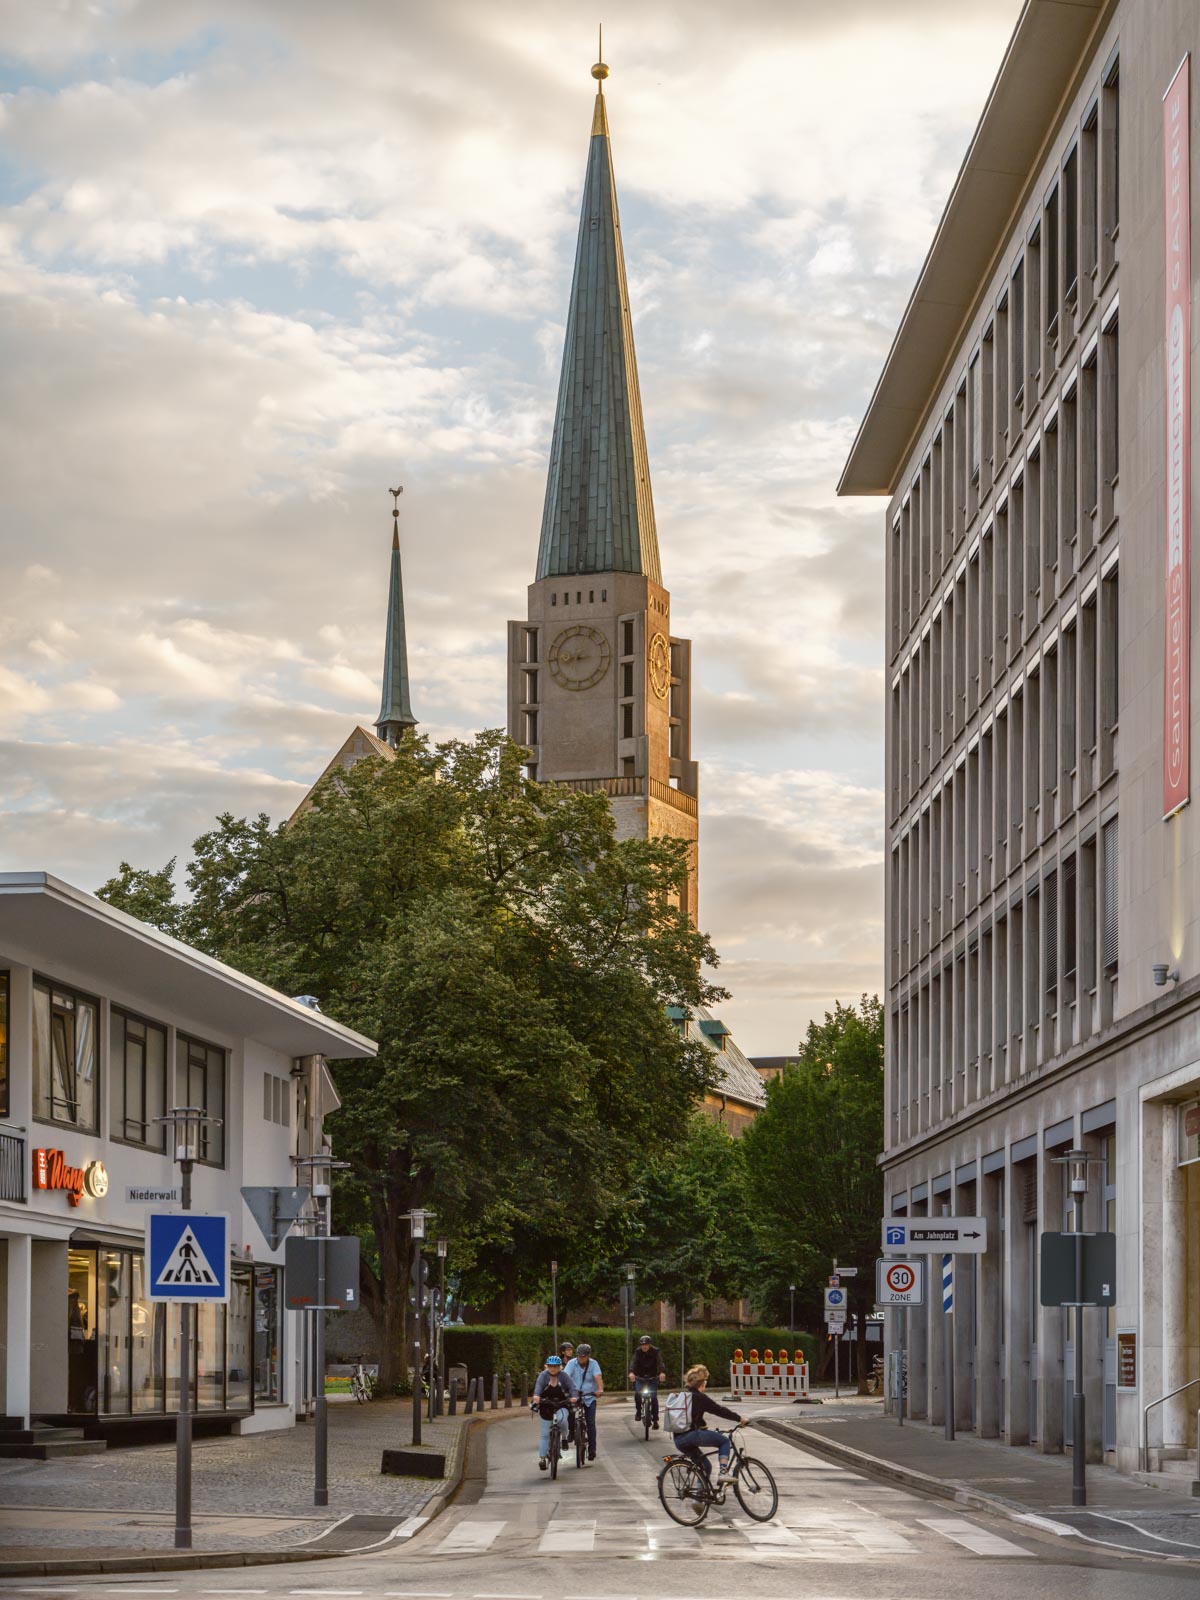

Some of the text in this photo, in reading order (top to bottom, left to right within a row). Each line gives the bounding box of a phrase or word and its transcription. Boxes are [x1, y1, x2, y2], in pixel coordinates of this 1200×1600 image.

[1171, 95, 1180, 291] GALERIE
[1170, 573, 1181, 768] samuelis
[48, 1147, 84, 1207] Wang
[130, 1189, 177, 1201] Niederwall
[892, 1231, 955, 1244] P Am Jahnplatz
[892, 1271, 909, 1285] 30
[890, 1293, 912, 1302] ZONE
